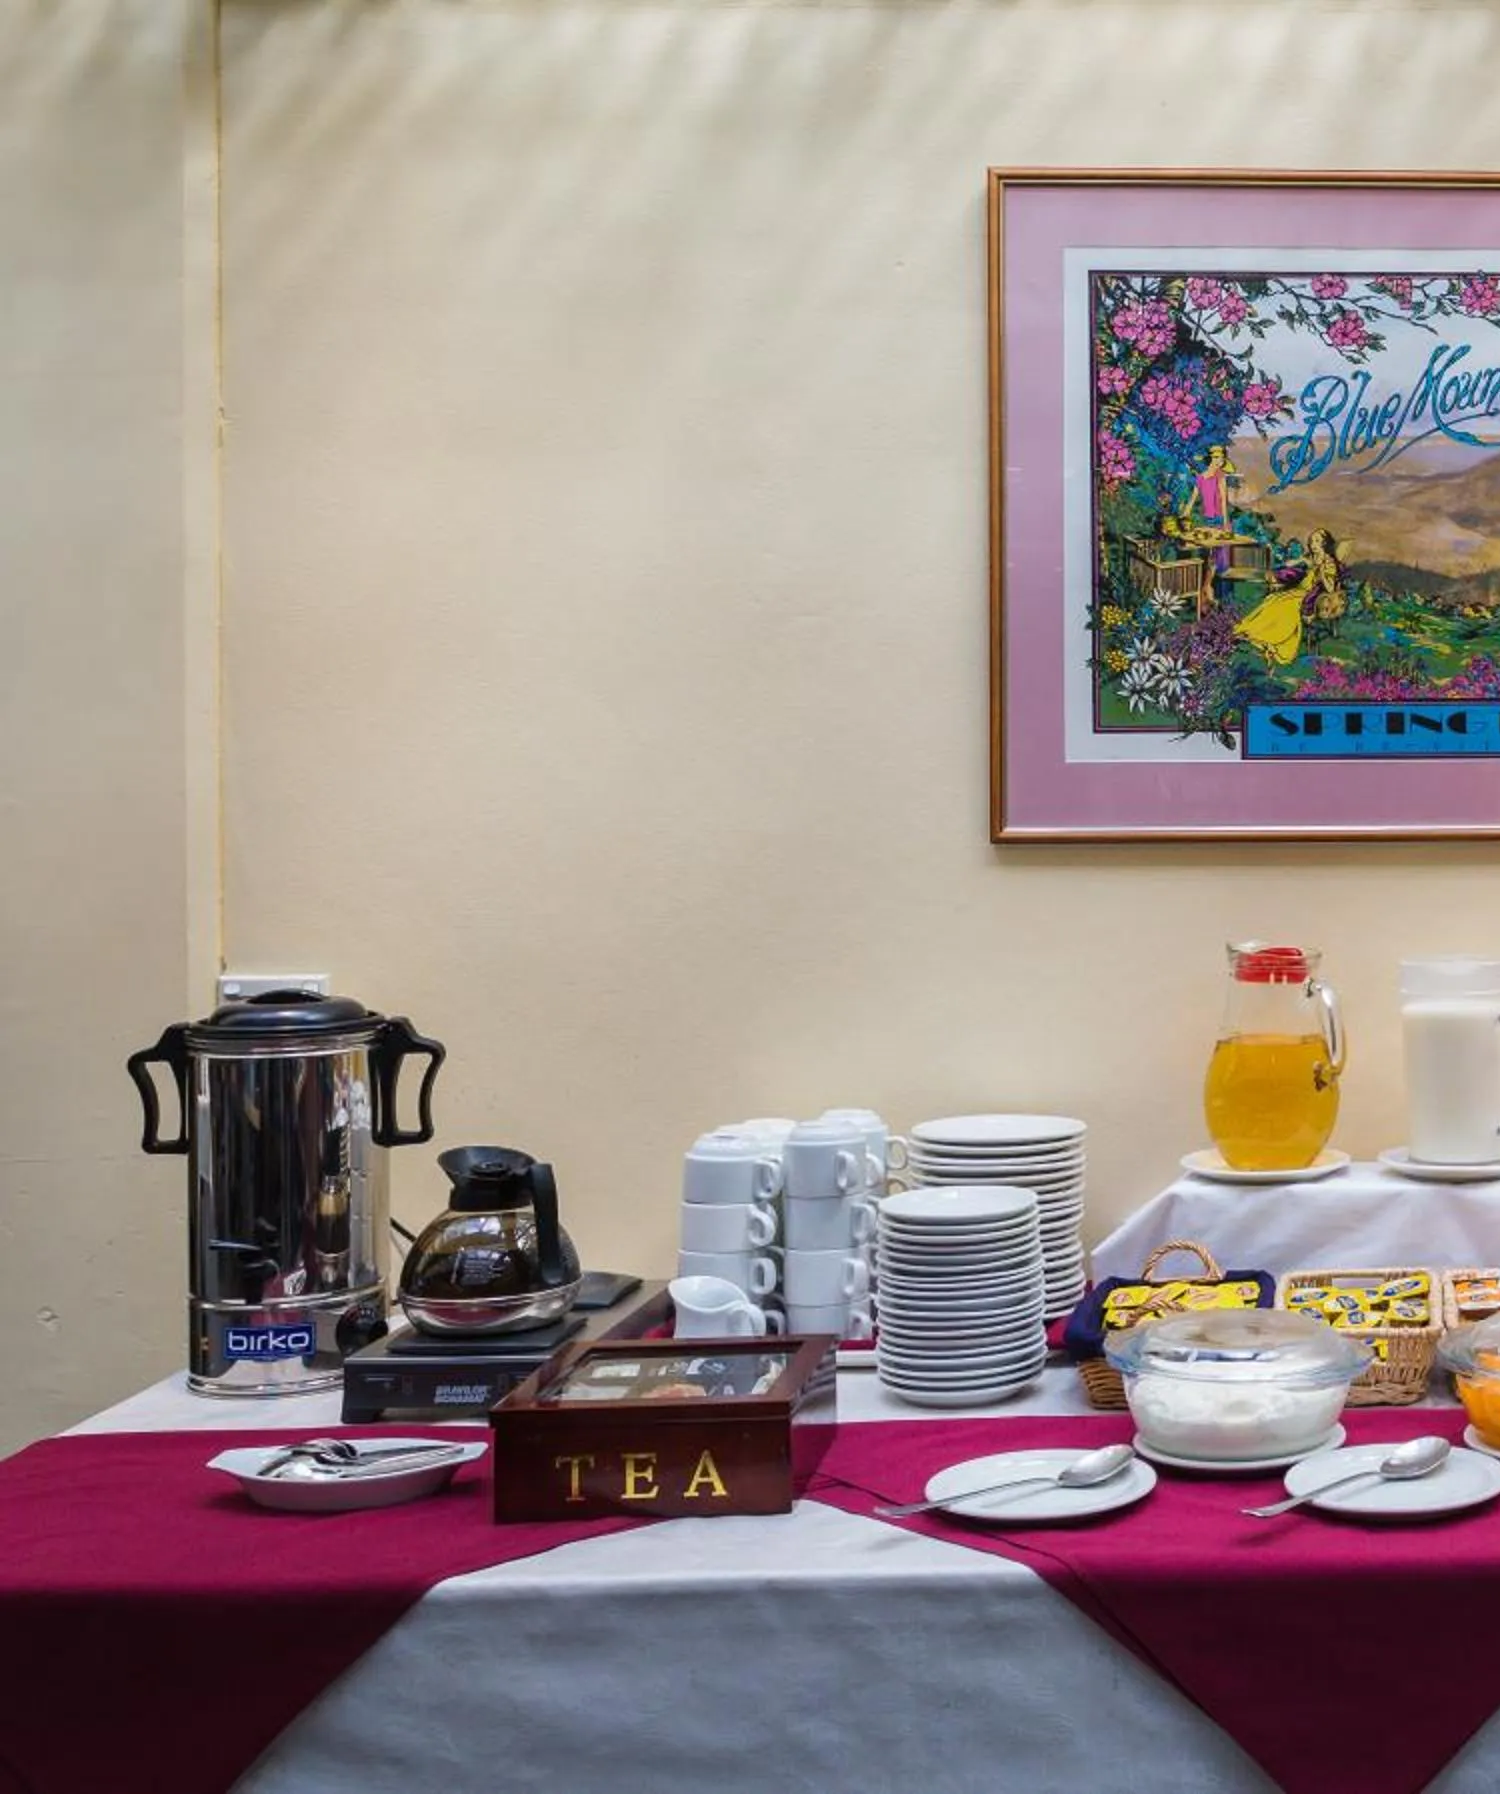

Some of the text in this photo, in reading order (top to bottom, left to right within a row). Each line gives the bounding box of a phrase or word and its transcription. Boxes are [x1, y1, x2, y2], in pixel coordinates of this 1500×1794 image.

[1269, 370, 1402, 493] Blue
[228, 1330, 310, 1352] birko
[555, 1449, 728, 1502] TEA
